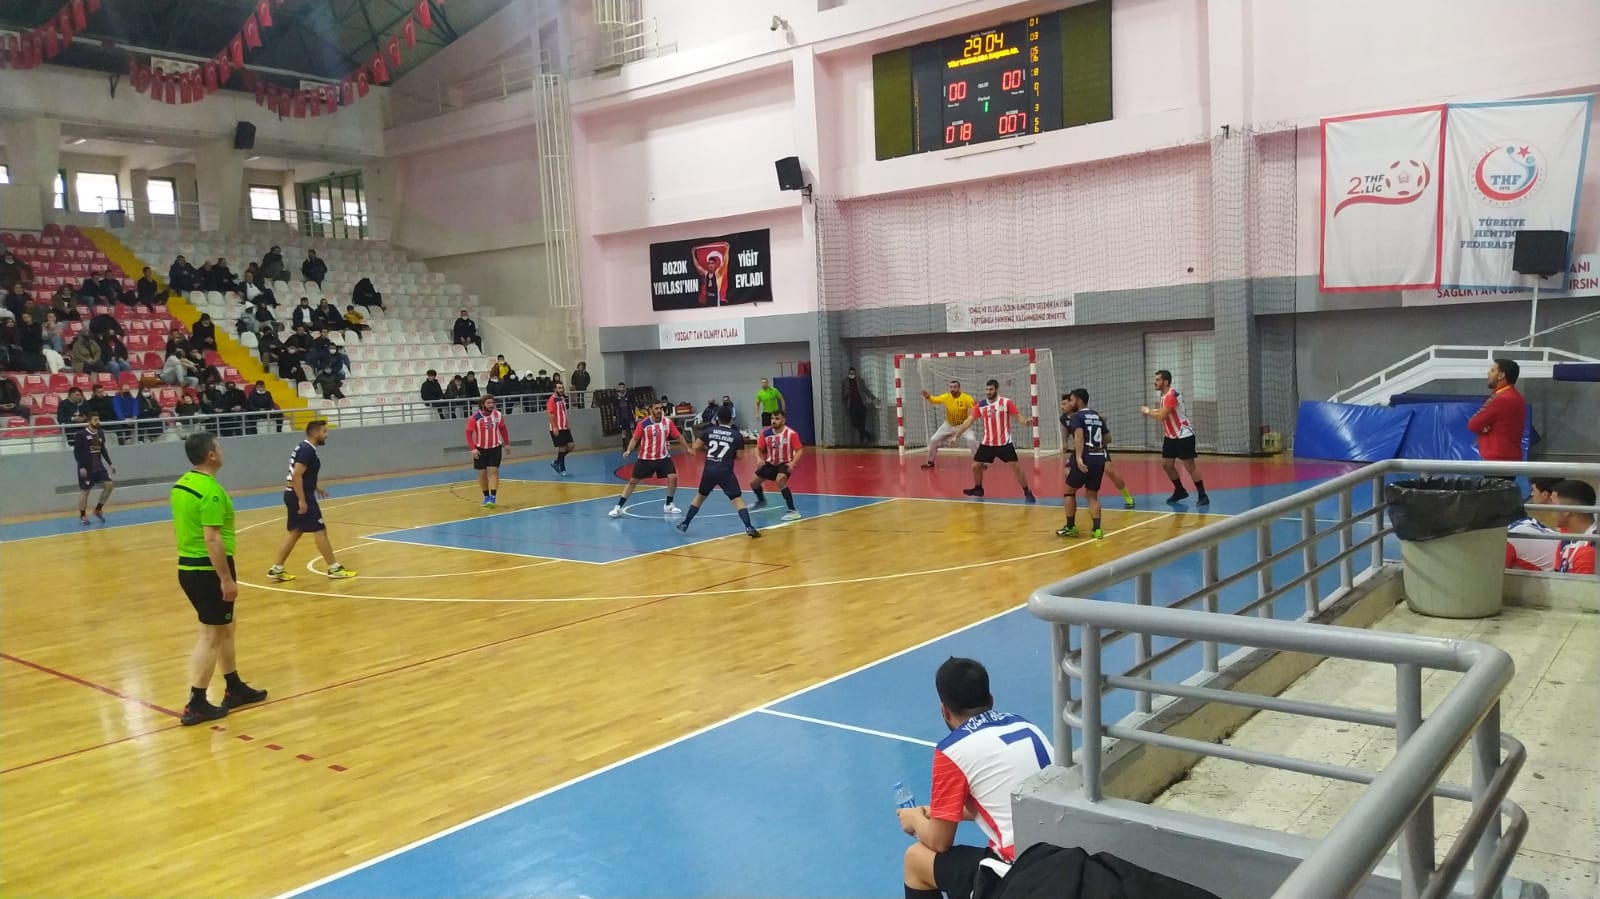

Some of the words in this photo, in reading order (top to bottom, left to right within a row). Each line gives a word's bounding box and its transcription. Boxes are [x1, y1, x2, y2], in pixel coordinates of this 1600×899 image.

[1002, 69, 1021, 91] 00
[949, 81, 966, 101] 00
[999, 112, 1026, 134] 007
[945, 122, 972, 144] 018
[1364, 174, 1385, 184] THF
[1490, 174, 1522, 186] THF
[1474, 229, 1515, 238] HENTB
[1460, 240, 1515, 249] FEDERASY
[738, 249, 759, 268] YİĞİT
[662, 260, 688, 276] BOZOK
[735, 271, 764, 289] EVLADI
[1085, 425, 1103, 448] 14
[706, 440, 730, 458] 27
[999, 727, 1051, 770] 7
